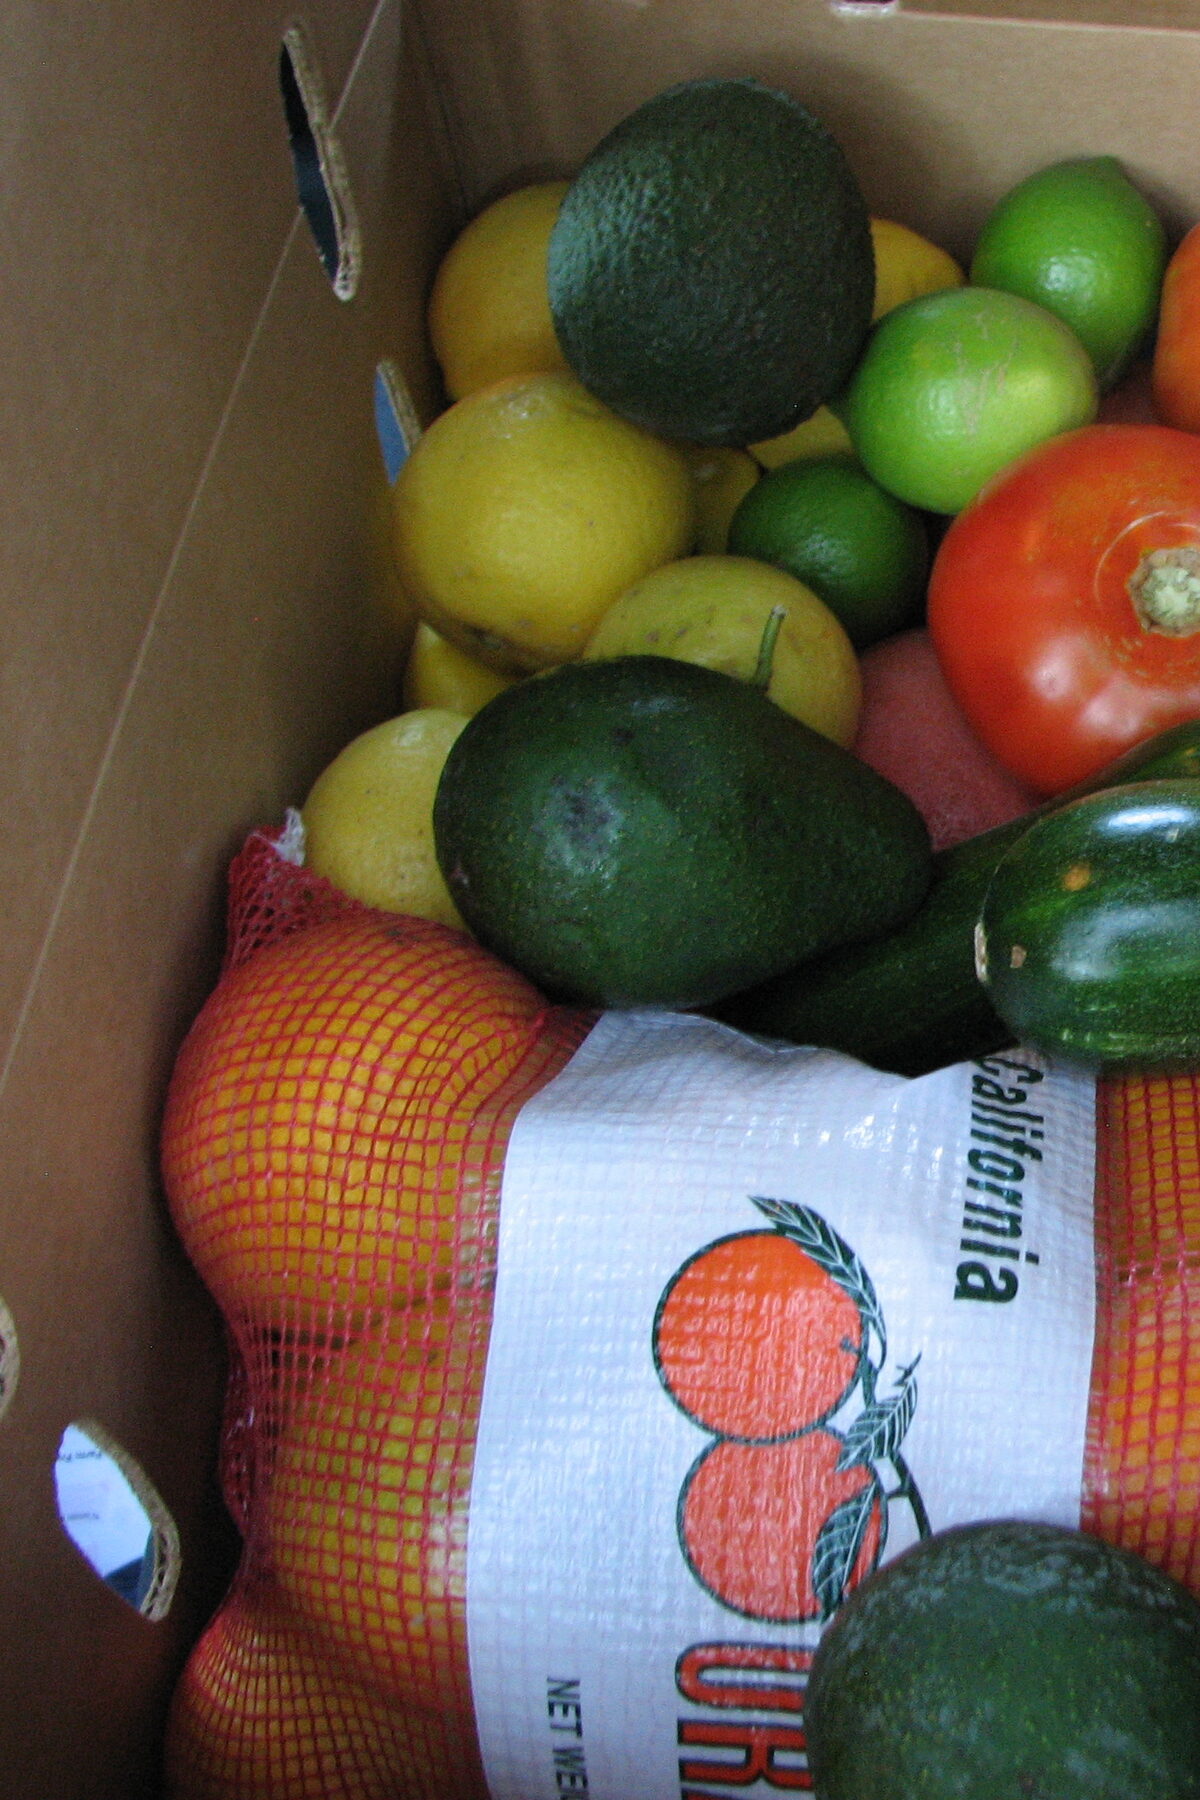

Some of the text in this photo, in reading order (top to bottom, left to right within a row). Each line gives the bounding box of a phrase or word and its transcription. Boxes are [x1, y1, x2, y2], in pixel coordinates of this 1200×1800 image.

[953, 1057, 1044, 1303] California
[546, 1676, 590, 1800] NET WEI
